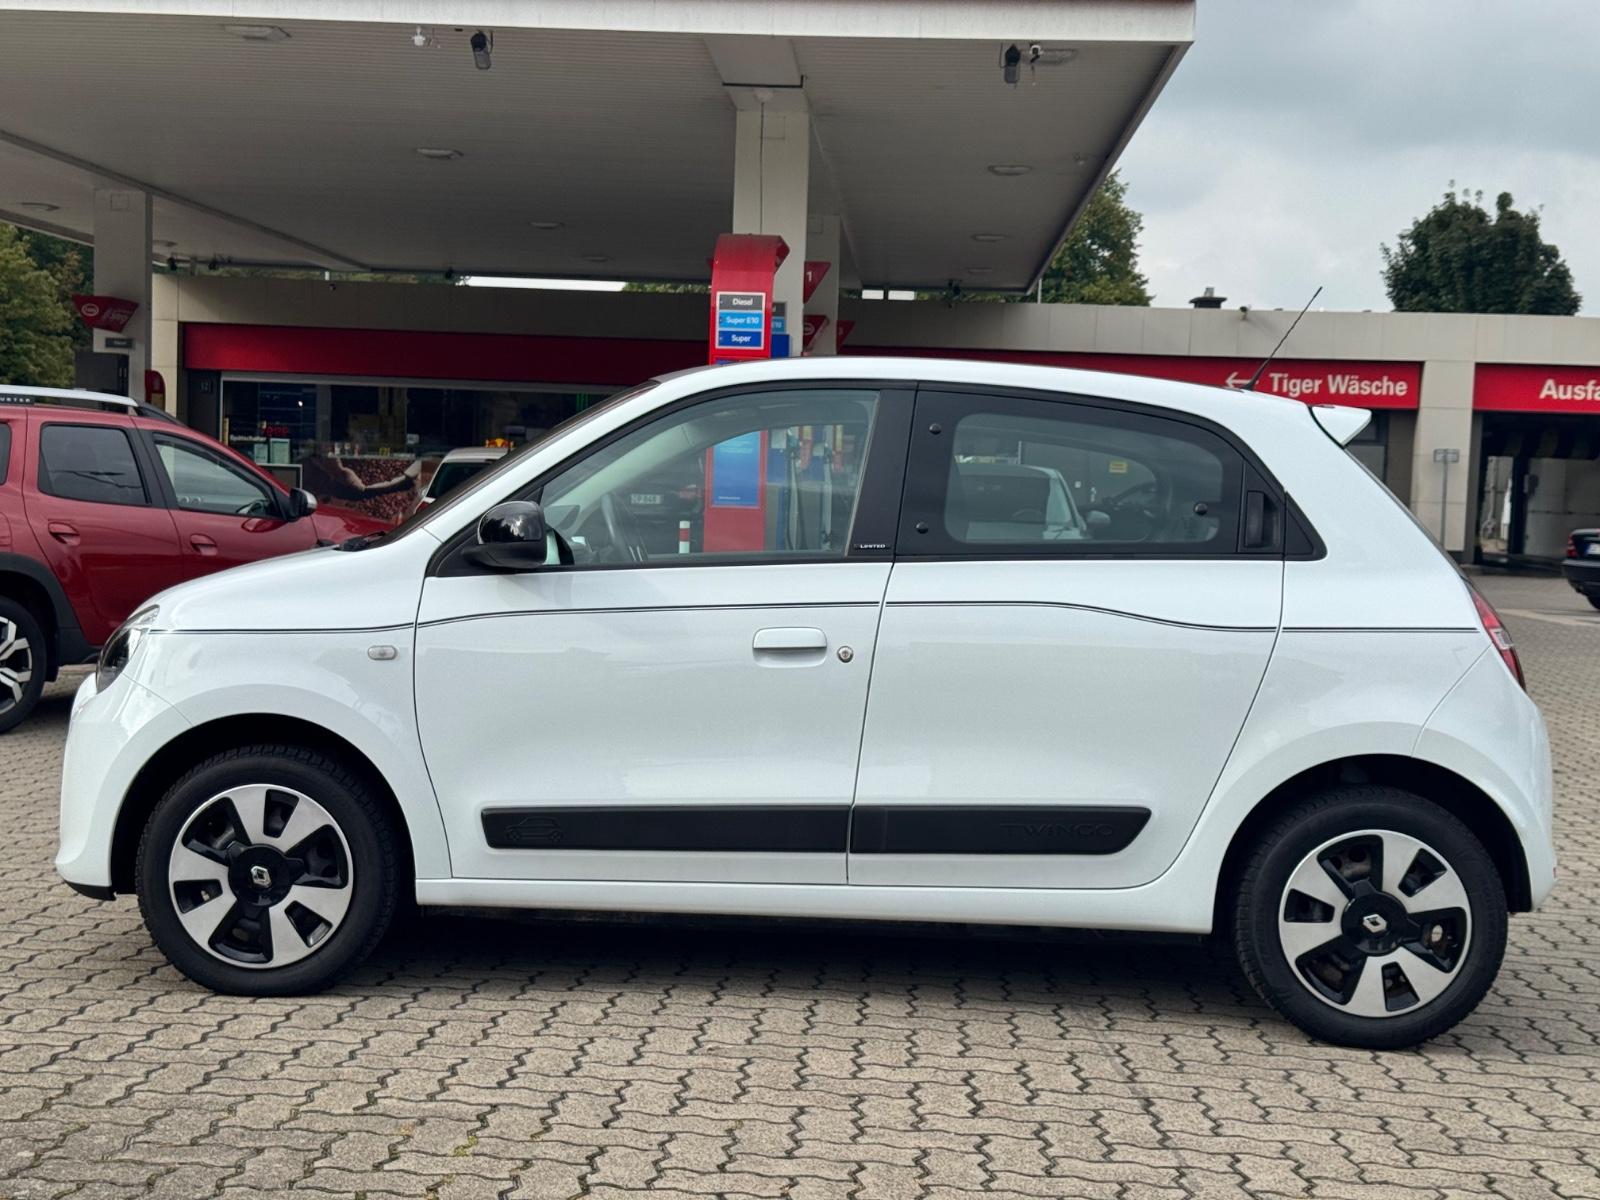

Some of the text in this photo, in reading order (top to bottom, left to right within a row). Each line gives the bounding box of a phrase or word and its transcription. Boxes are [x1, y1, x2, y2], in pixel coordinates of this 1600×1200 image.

[732, 297, 753, 306] Diesel
[726, 317, 760, 325] Super E10
[731, 335, 751, 344] Super
[1269, 372, 1409, 398] Tiger Wäsche
